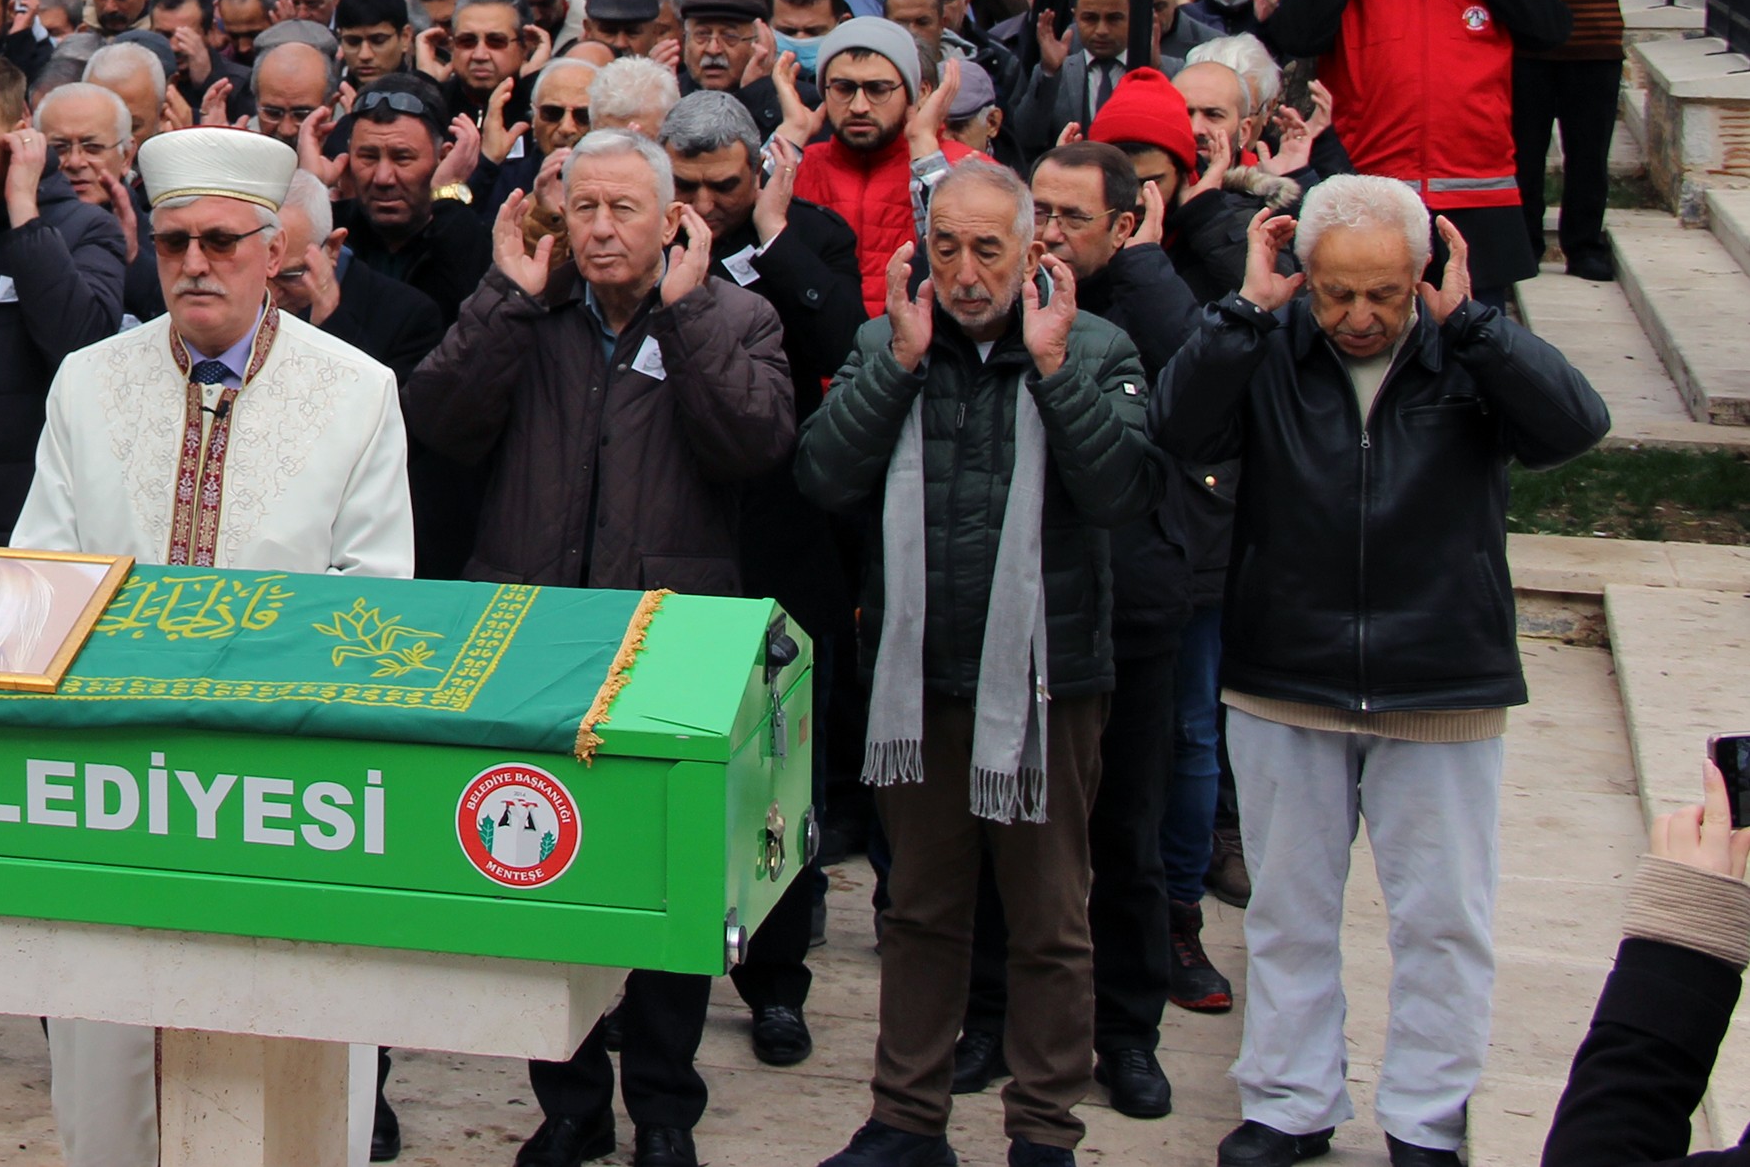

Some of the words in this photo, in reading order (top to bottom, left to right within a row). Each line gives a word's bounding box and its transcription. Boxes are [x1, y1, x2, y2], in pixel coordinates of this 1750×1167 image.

[466, 772, 512, 810] BELEDİYE
[515, 773, 571, 824] BAŞKANLIĞI
[485, 860, 545, 882] MENTEŞE
